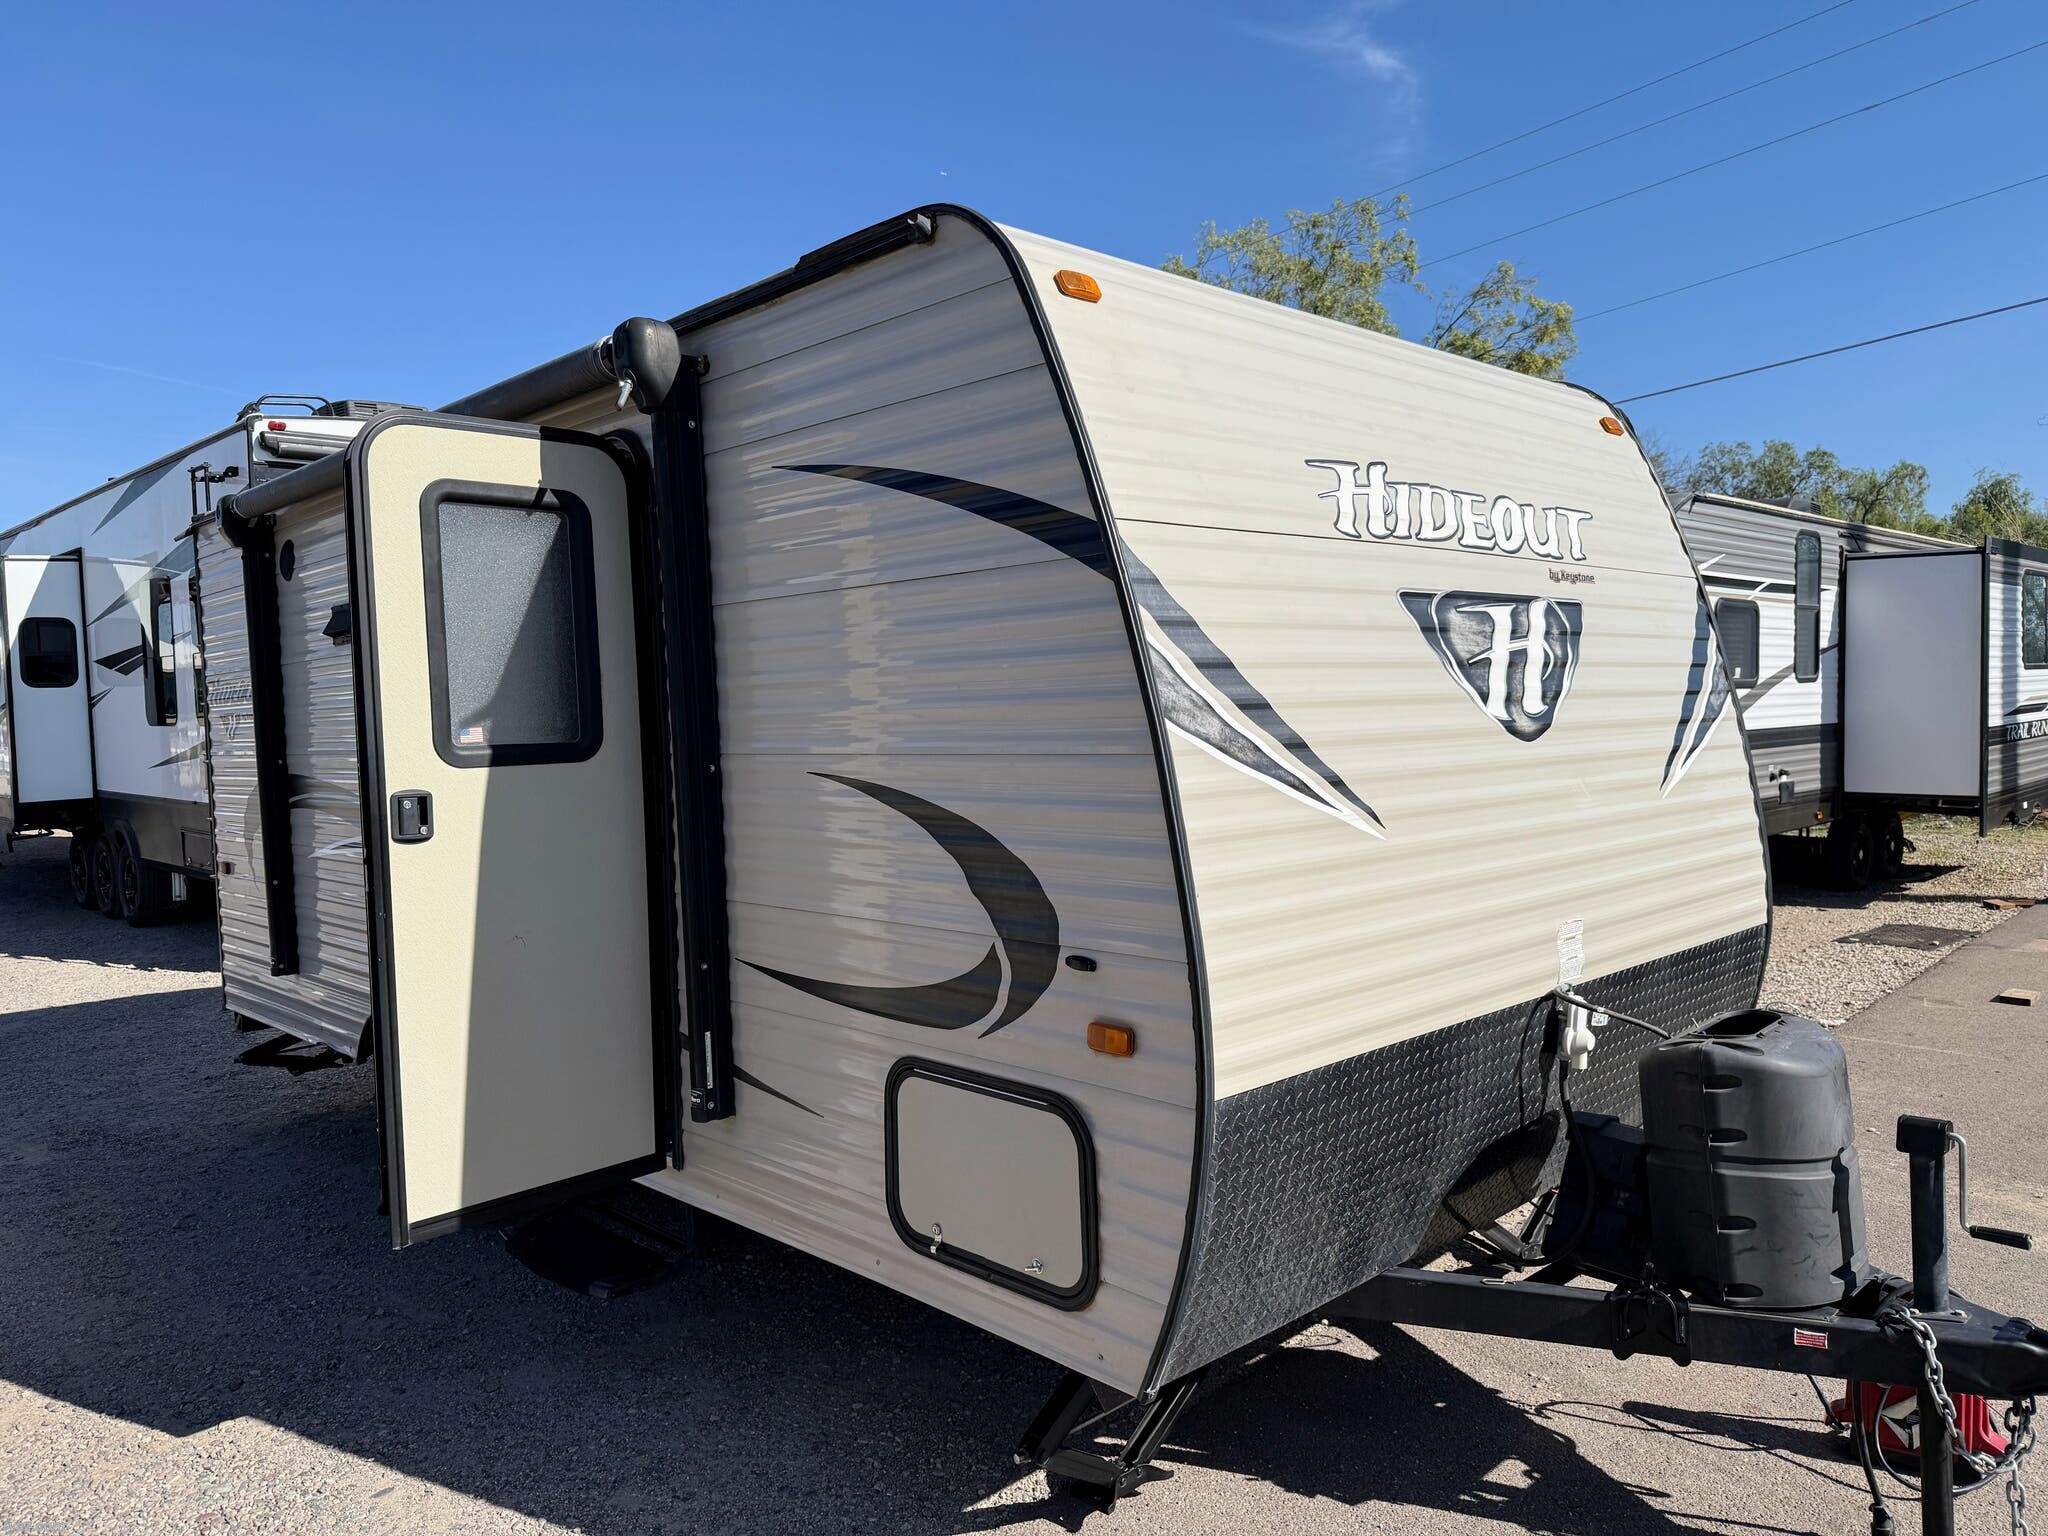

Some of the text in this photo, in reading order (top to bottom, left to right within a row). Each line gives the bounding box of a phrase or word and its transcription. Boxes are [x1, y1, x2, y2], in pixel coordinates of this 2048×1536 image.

[1304, 458, 1593, 561] HIDEOUT
[1548, 567, 1595, 584] by Keystone
[2005, 722, 2030, 741] TRAIL
